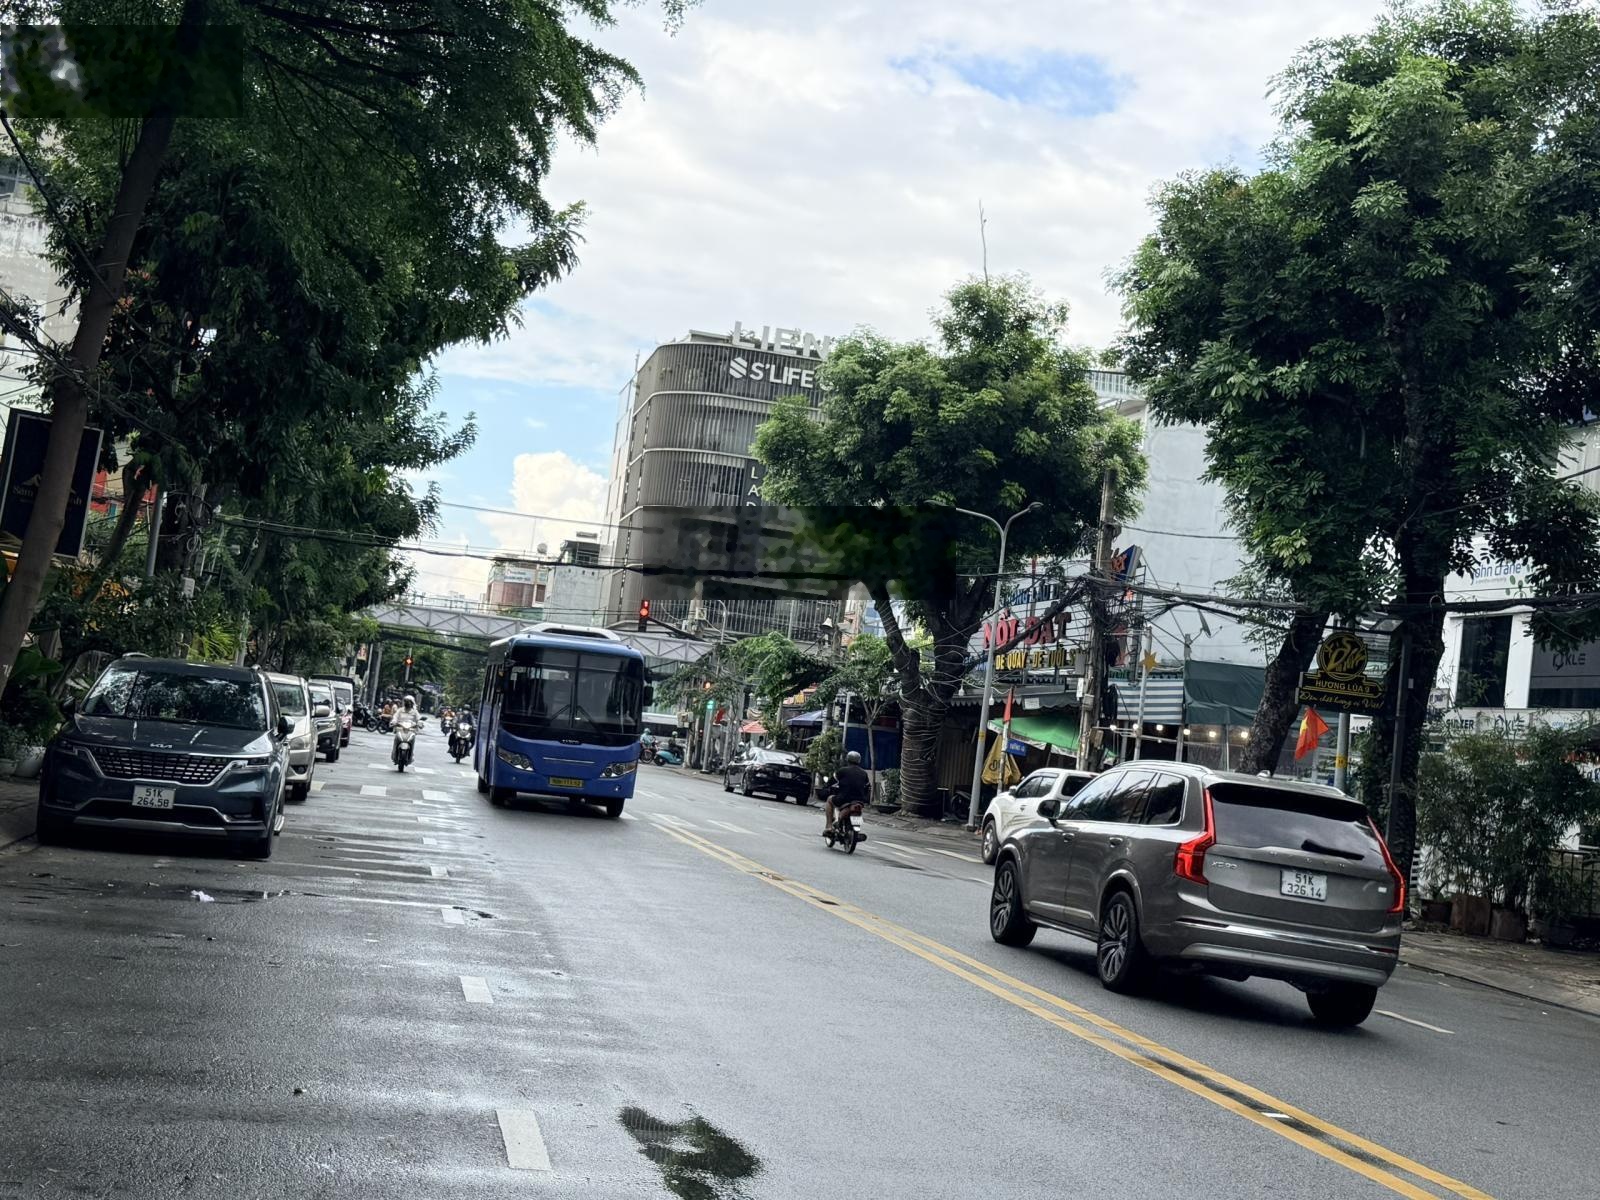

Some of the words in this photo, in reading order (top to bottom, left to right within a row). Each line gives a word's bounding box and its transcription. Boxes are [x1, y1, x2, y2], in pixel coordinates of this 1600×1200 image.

[749, 361, 815, 389] S'LIFE
[145, 788, 162, 798] 51K
[1295, 873, 1314, 886] 51K
[1287, 883, 1322, 897] 326.14
